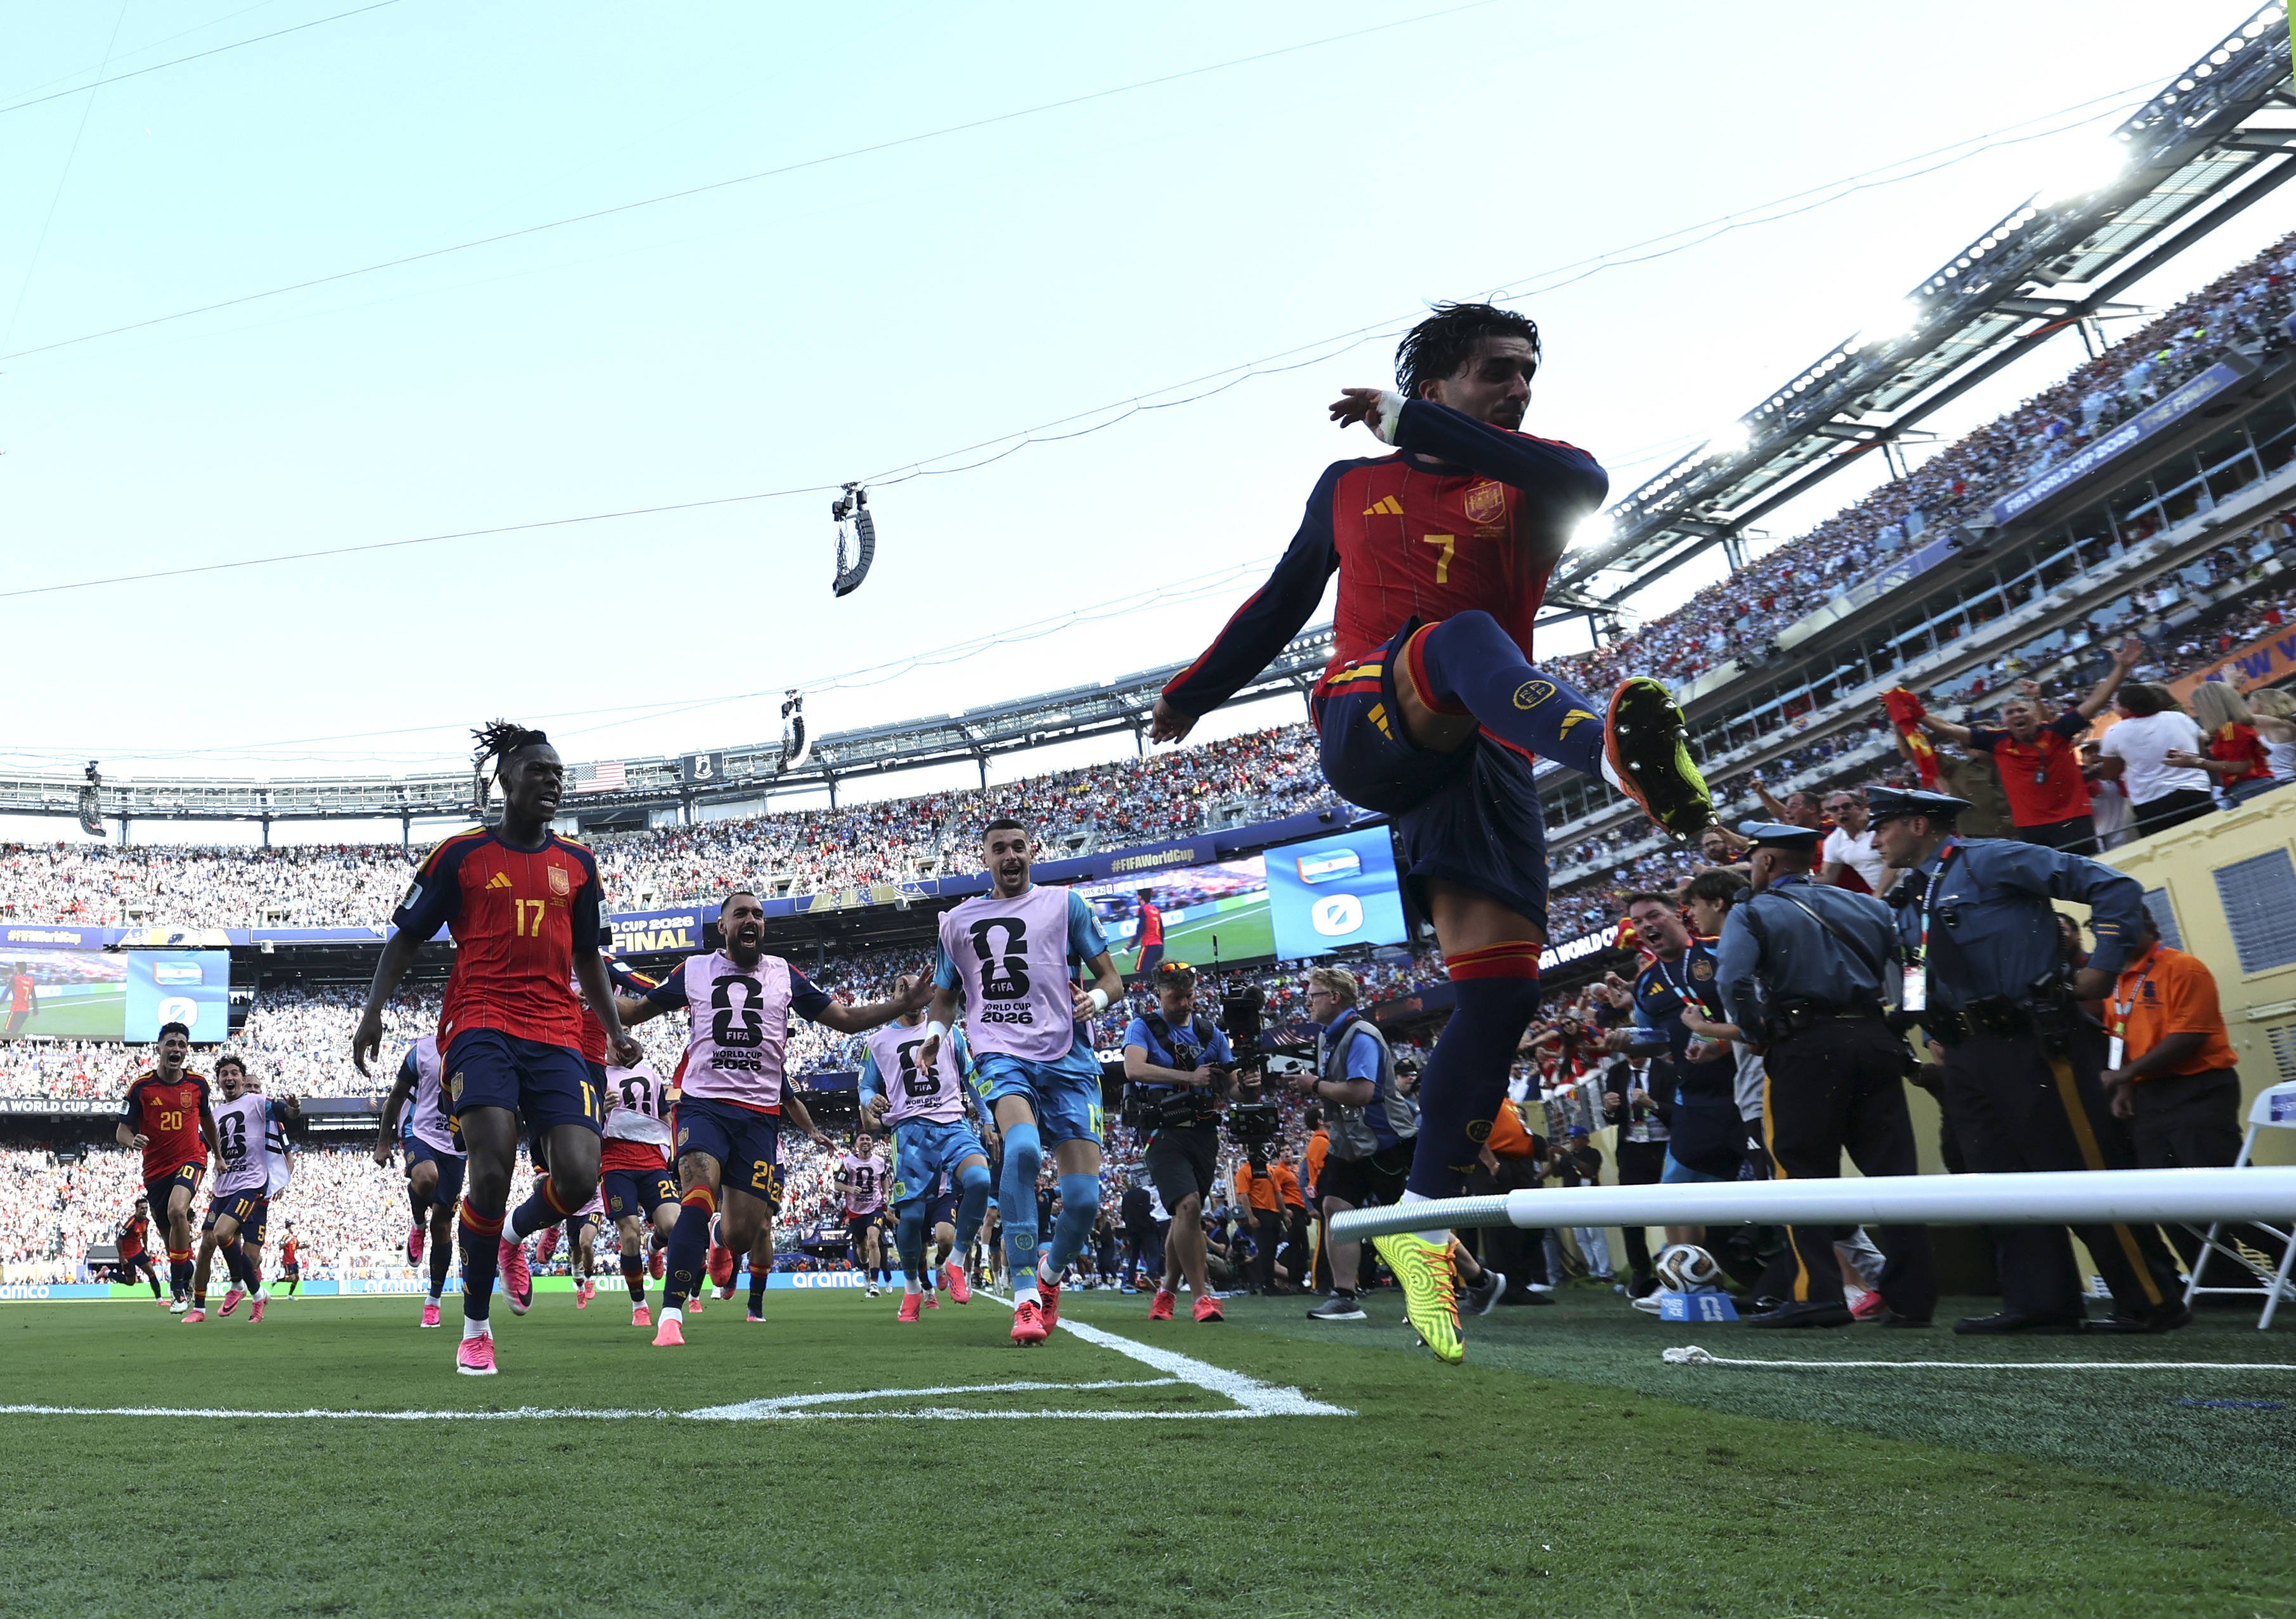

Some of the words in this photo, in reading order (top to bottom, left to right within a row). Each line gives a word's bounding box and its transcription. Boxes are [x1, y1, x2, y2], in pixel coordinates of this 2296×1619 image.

[1423, 534, 1454, 584] 7
[1111, 849, 1194, 872] #FIFAWorldCup
[515, 899, 545, 937] 17
[621, 920, 648, 933] CUP
[649, 916, 695, 930] 2026
[608, 929, 695, 954] FINAL
[1556, 933, 1603, 963] WORLD
[991, 982, 1015, 992] FIFA
[1013, 1002, 1031, 1011] CUP
[980, 1012, 1033, 1025] 2026
[726, 1032, 750, 1040] FIFA
[745, 1051, 762, 1059] CUP
[712, 1059, 762, 1071] 2026
[914, 1084, 932, 1092] FIFA
[11, 1101, 60, 1112] WORLD
[62, 1101, 89, 1112] CUP
[160, 1111, 182, 1131] 20
[235, 1198, 249, 1216] 11
[589, 1213, 599, 1224] 10
[873, 1216, 883, 1226] 14
[258, 1225, 266, 1242] 5
[365, 1278, 431, 1294] aramc
[792, 1271, 865, 1288] aramc
